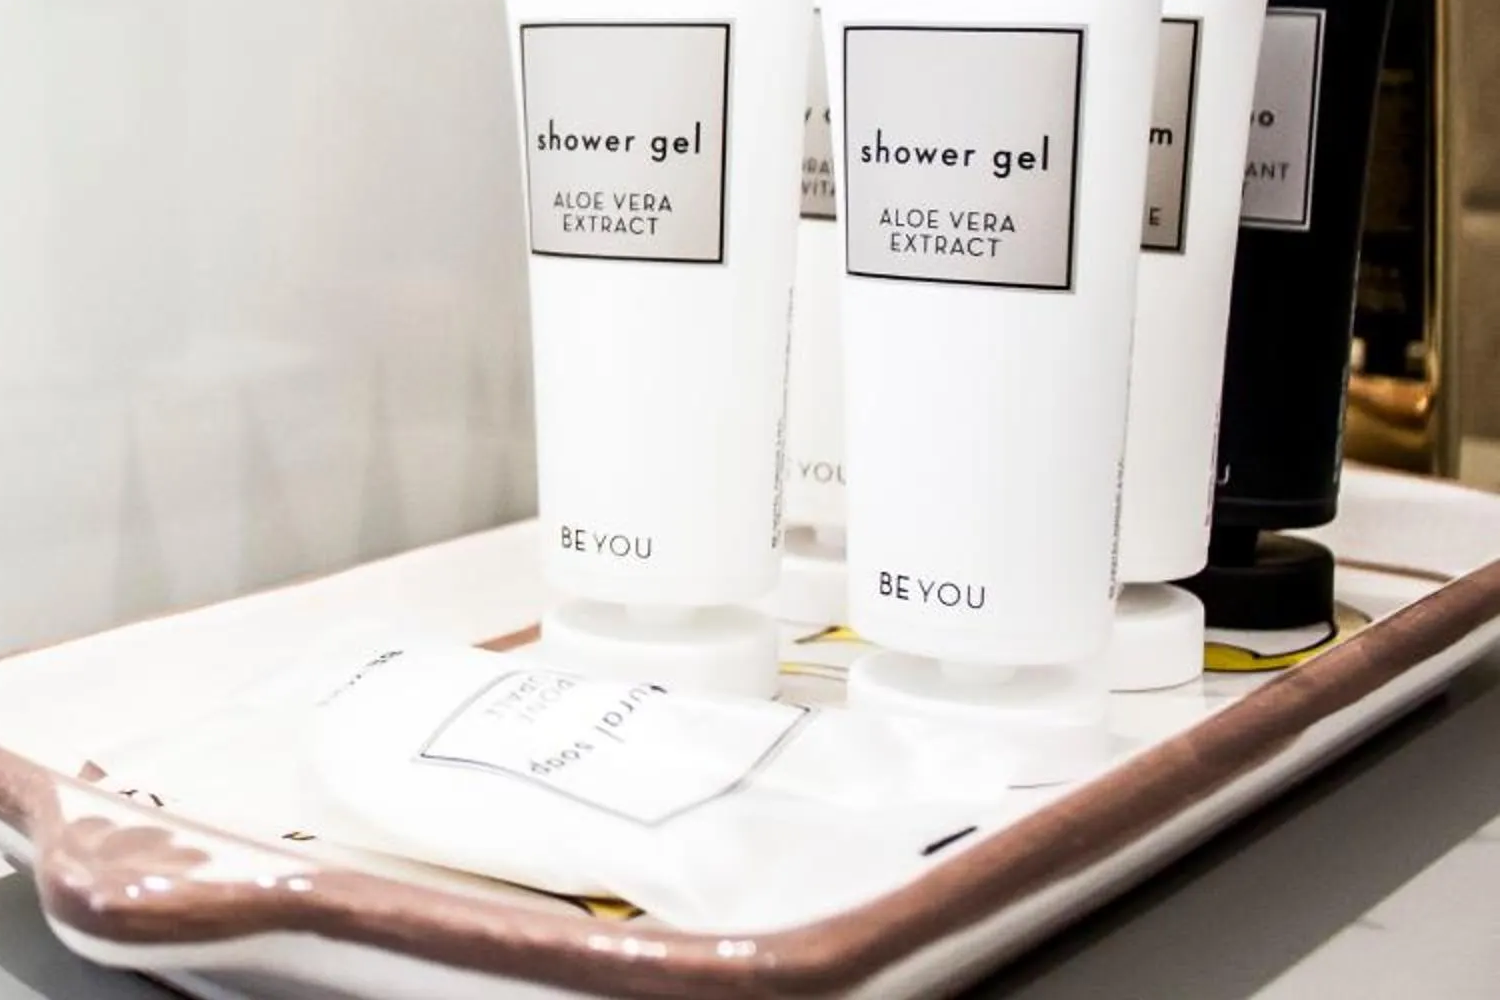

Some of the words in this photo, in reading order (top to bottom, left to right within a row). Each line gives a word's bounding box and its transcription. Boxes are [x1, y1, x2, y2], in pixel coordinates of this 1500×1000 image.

[536, 119, 636, 153] shower
[650, 121, 702, 163] gel
[860, 128, 977, 168] shower
[992, 134, 1051, 180] gel
[553, 191, 604, 211] ALOE
[613, 192, 673, 213] VERA
[562, 212, 661, 237] EXTRACT
[878, 207, 940, 230] ALOE
[949, 210, 1017, 234] VERA
[889, 231, 1004, 258] EXTRACT
[561, 525, 587, 553] BE
[593, 534, 653, 560] YOU
[879, 571, 911, 601] BE
[917, 578, 986, 610] YOU
